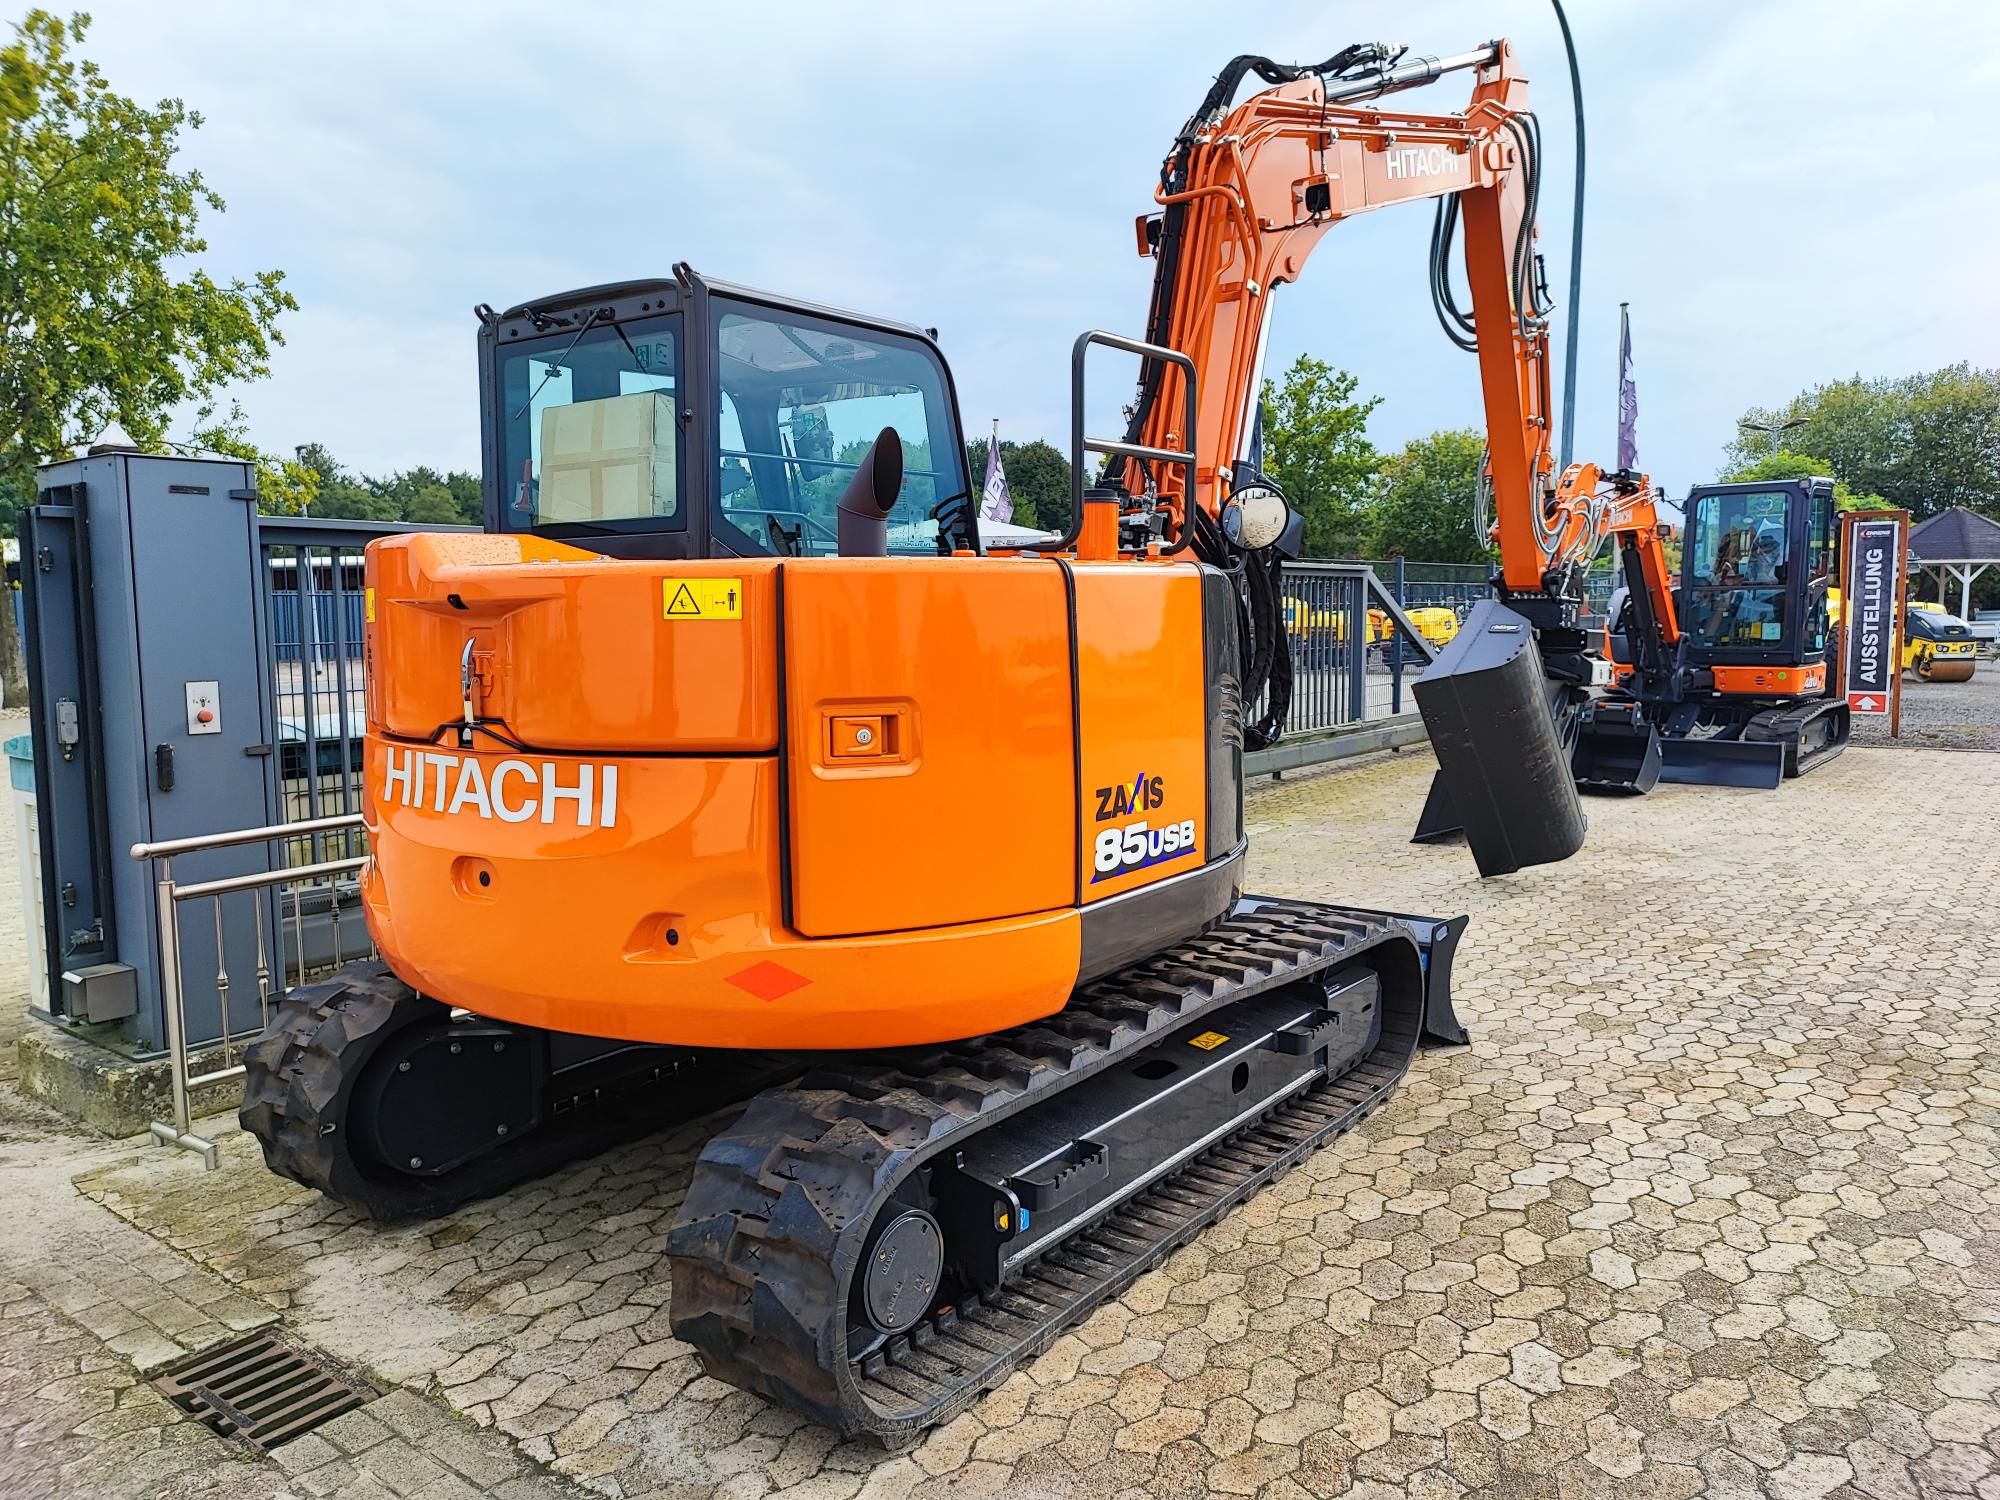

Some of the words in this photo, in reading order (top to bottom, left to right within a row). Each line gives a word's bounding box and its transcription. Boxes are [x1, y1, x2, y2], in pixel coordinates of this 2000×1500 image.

[1386, 147, 1459, 180] HITACHI
[1860, 548, 1883, 684] AUSSTELLUNG
[383, 746, 618, 828] HITACHI
[1095, 772, 1164, 822] ZAXIS
